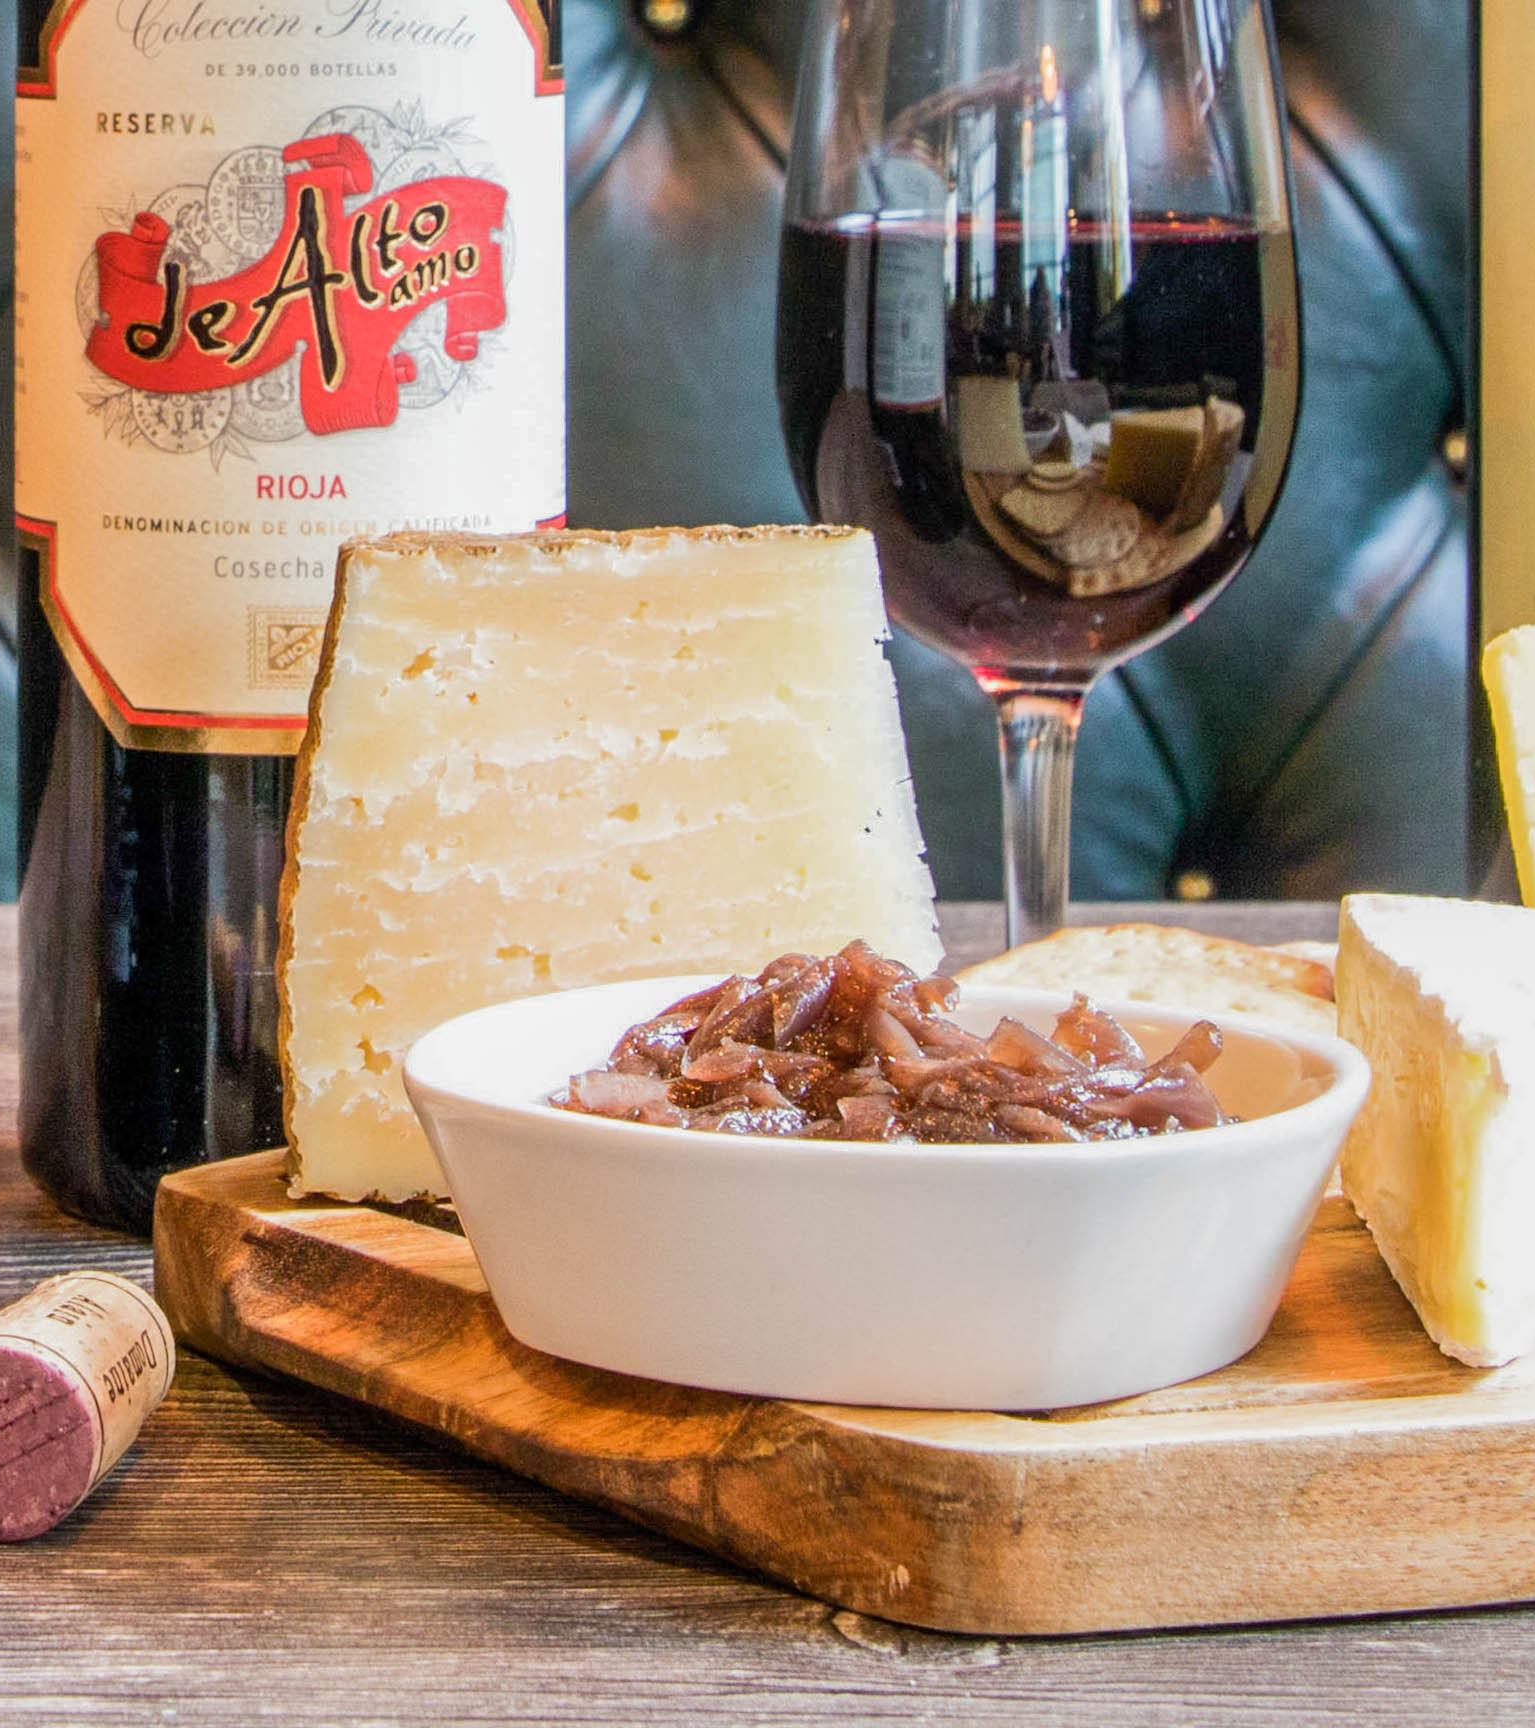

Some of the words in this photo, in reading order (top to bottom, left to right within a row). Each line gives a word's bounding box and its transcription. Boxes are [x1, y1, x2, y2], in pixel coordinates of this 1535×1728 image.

[205, 63, 226, 77] DE
[310, 63, 398, 78] BOTELLAS
[96, 112, 216, 135] RESERVA
[124, 262, 235, 362] de
[226, 185, 449, 391] Alto
[389, 244, 479, 310] amo
[256, 474, 347, 500] RIOJA
[261, 520, 287, 536] DE
[214, 554, 325, 580] Cosecha
[102, 1329, 157, 1403] Domaine
